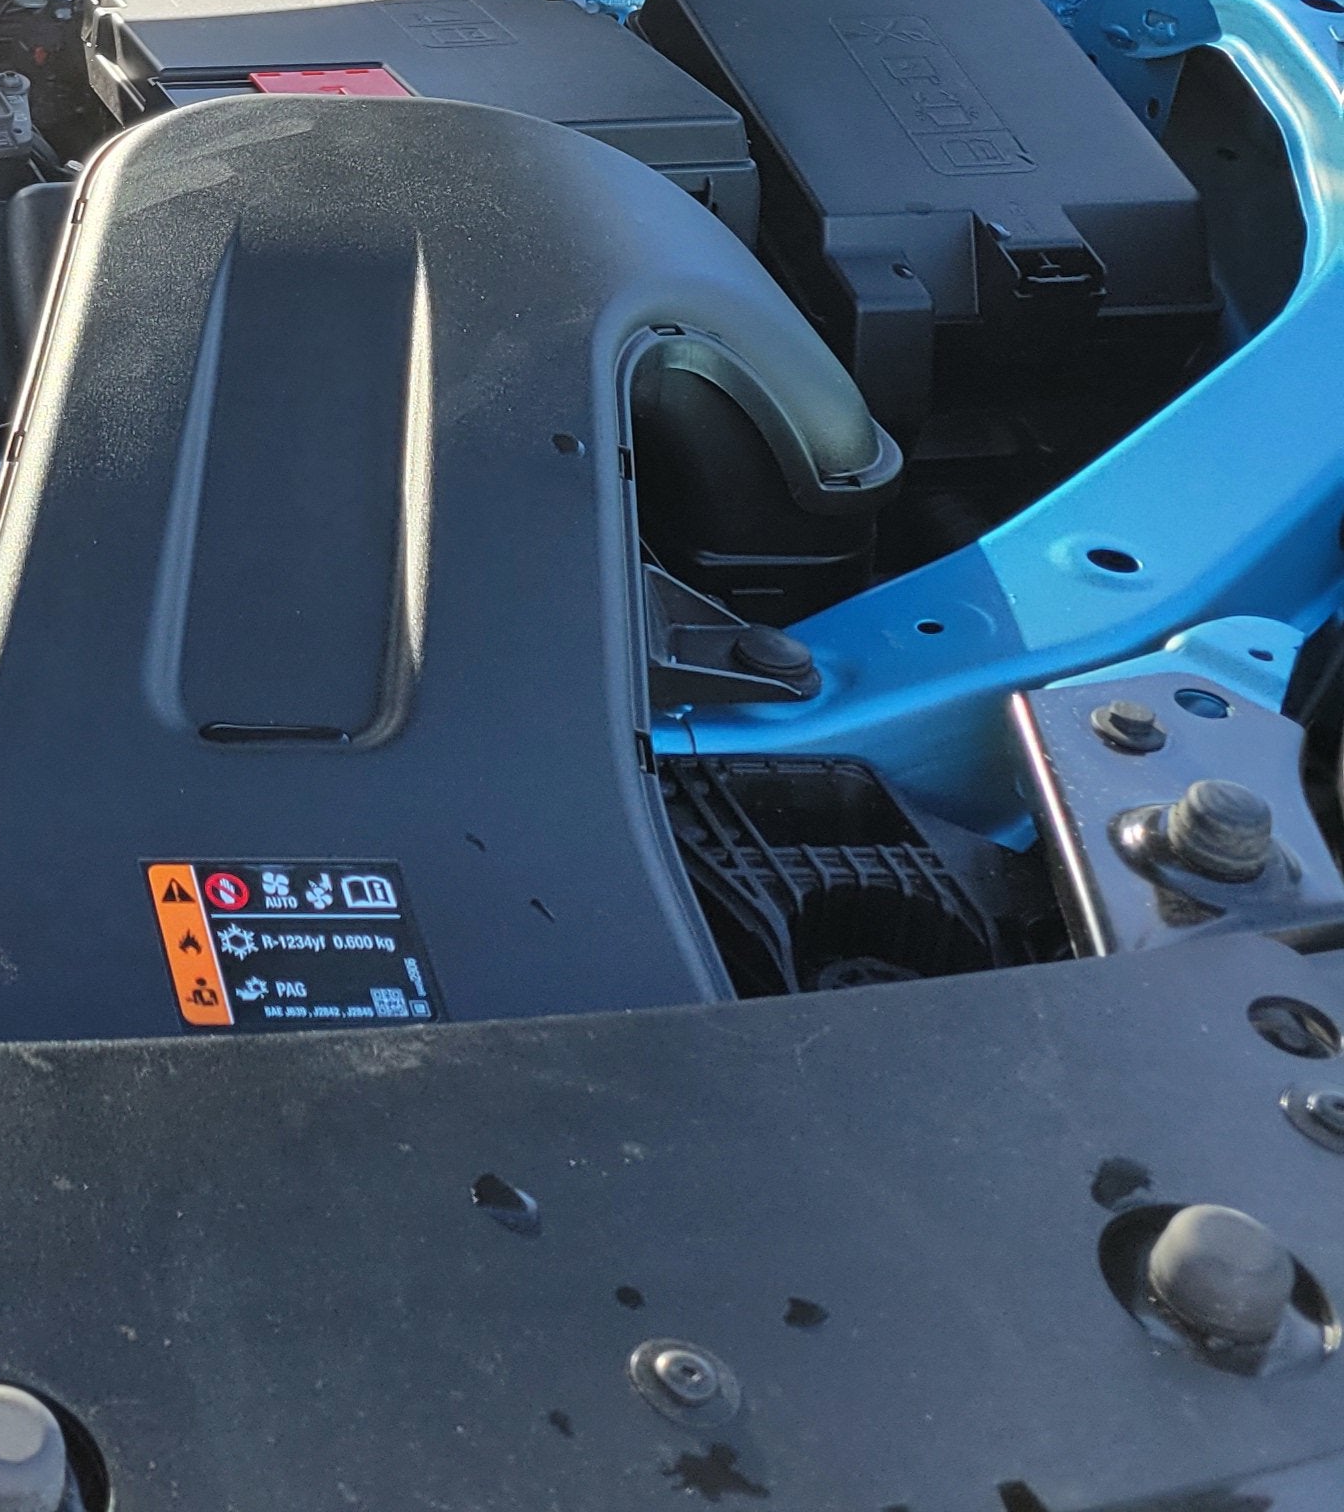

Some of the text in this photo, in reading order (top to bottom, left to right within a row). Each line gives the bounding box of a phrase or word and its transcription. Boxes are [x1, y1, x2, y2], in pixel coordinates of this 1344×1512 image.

[265, 896, 298, 909] AUTO
[261, 934, 395, 952] R-1234yf 0.600 kg
[275, 981, 308, 998] PAG
